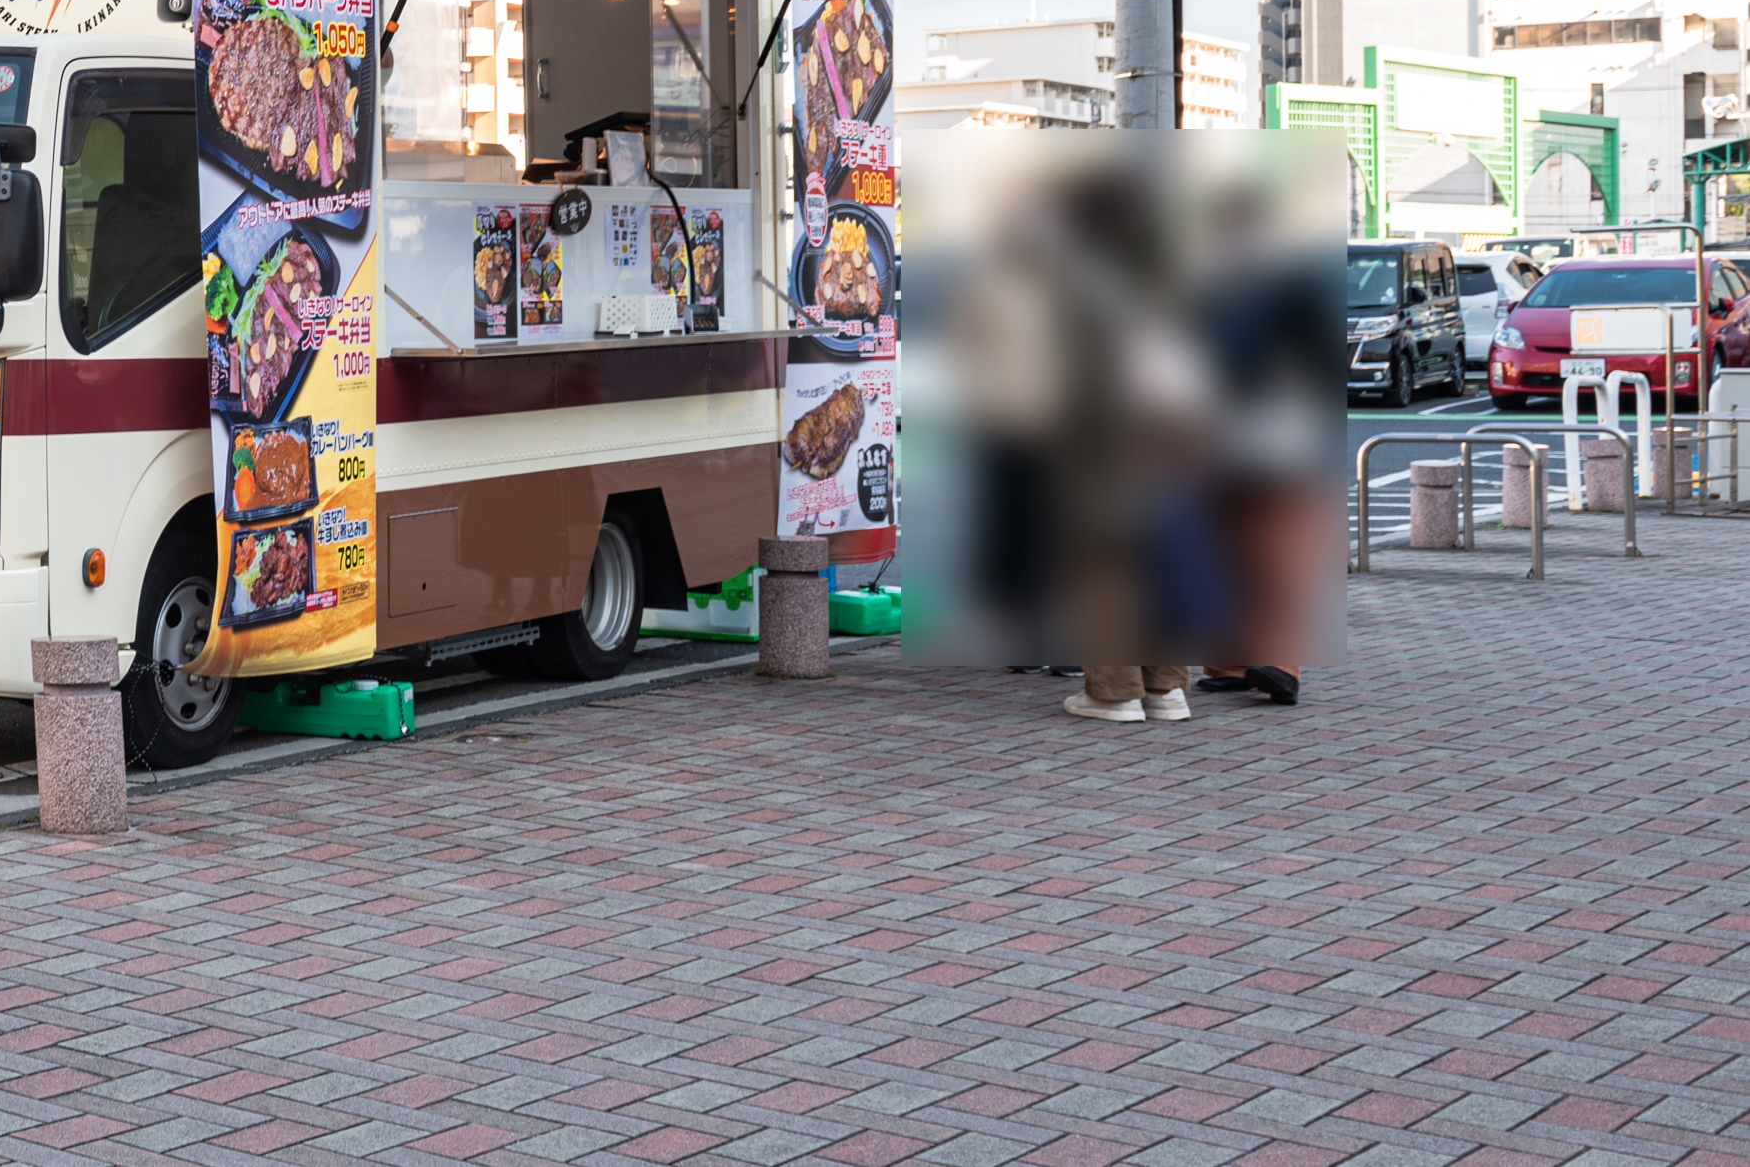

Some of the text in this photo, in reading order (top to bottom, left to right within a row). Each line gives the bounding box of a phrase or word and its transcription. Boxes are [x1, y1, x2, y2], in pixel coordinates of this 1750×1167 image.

[313, 21, 366, 57] 1,050円
[840, 139, 889, 171] ステーキ重
[852, 170, 892, 205] 1,000円
[558, 198, 588, 225] 営業中
[302, 316, 371, 350] ステーキ弁当
[333, 350, 370, 379] 1,000円
[338, 456, 366, 483] 800円
[337, 543, 365, 571] 780円
